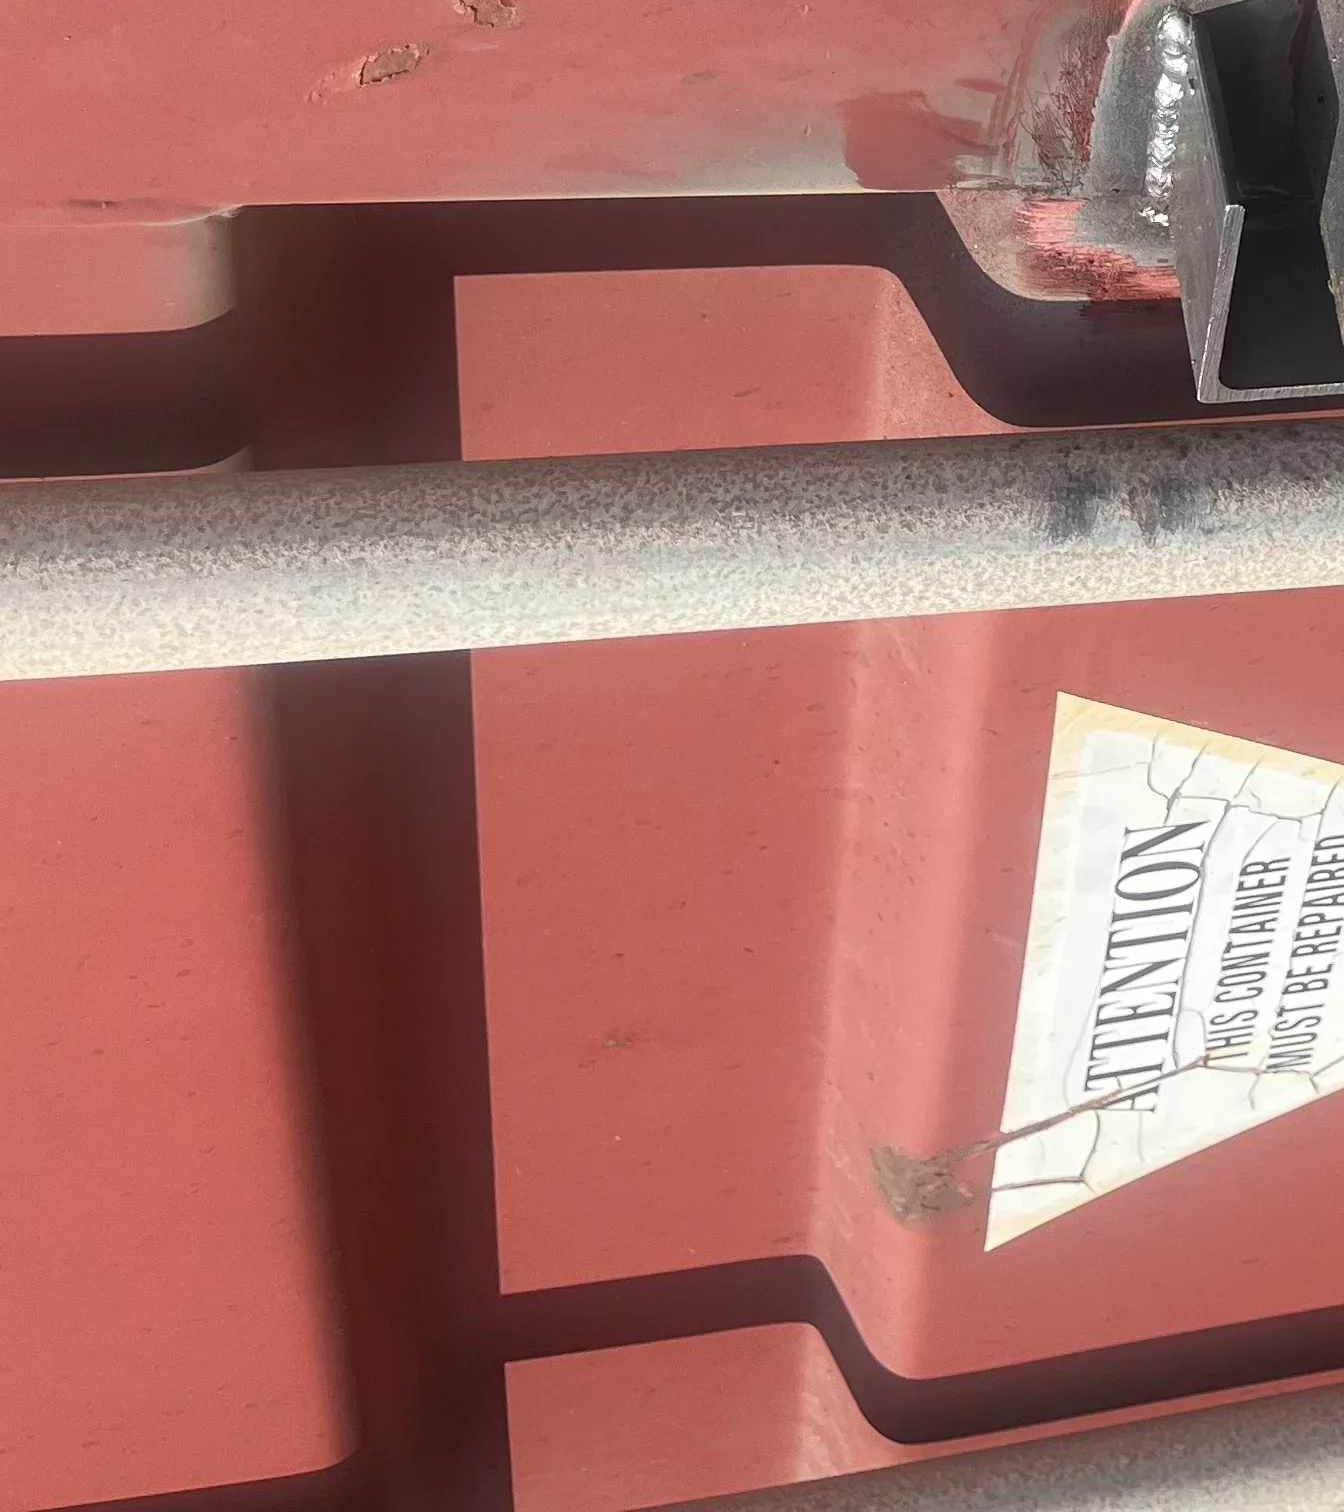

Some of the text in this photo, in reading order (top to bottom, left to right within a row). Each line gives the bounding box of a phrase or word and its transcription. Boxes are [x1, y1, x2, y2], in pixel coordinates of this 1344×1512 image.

[1084, 821, 1211, 1113] ATTENTION
[1203, 857, 1291, 1066] THIS CONTAINER
[1282, 963, 1332, 995] BE
[1266, 1004, 1324, 1070] MUST
